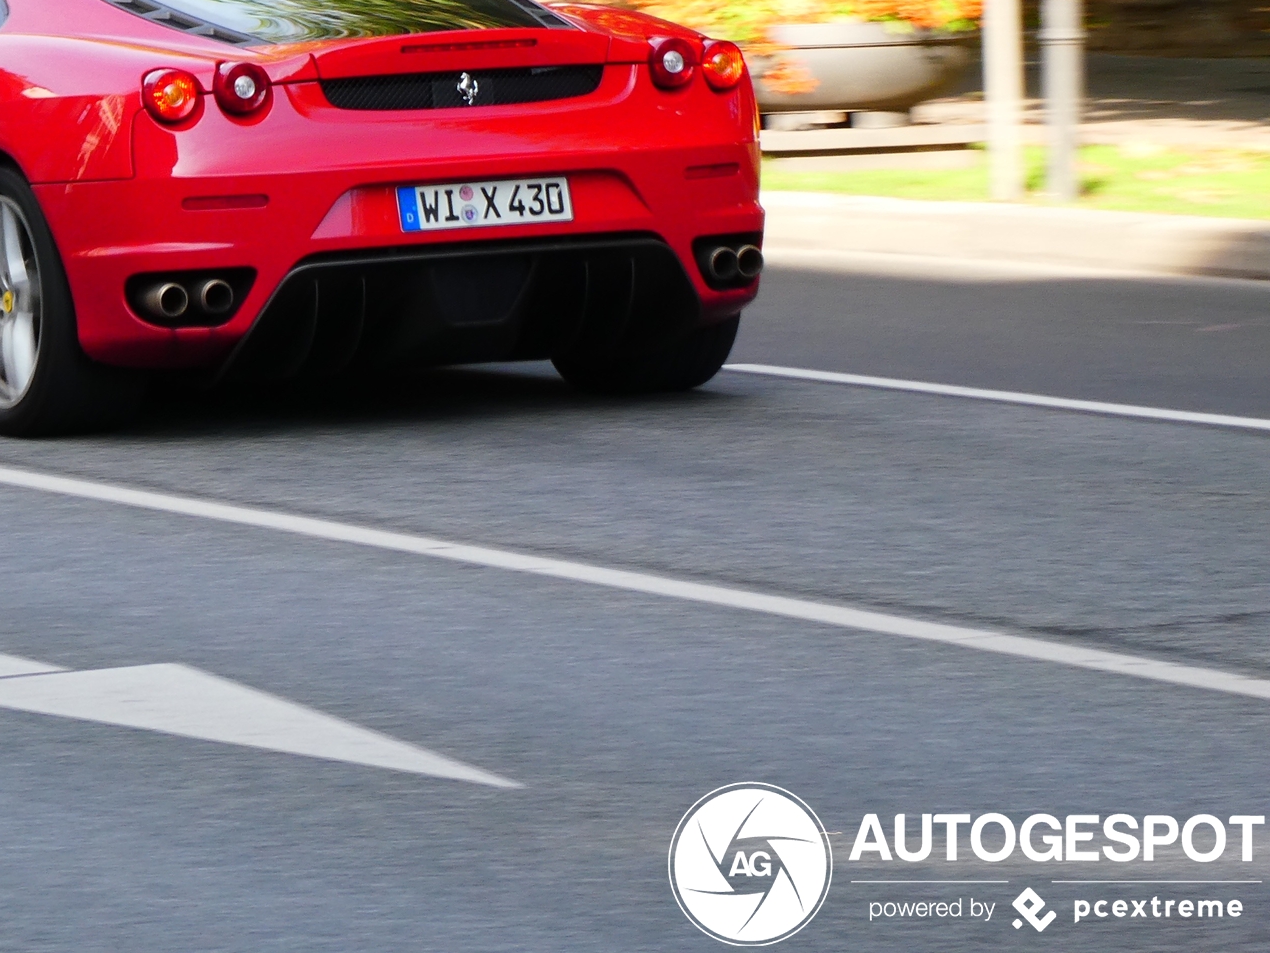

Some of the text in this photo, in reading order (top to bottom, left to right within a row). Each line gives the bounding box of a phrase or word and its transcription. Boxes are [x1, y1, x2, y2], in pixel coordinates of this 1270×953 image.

[419, 183, 564, 223] WI X 430
[406, 213, 414, 223] D
